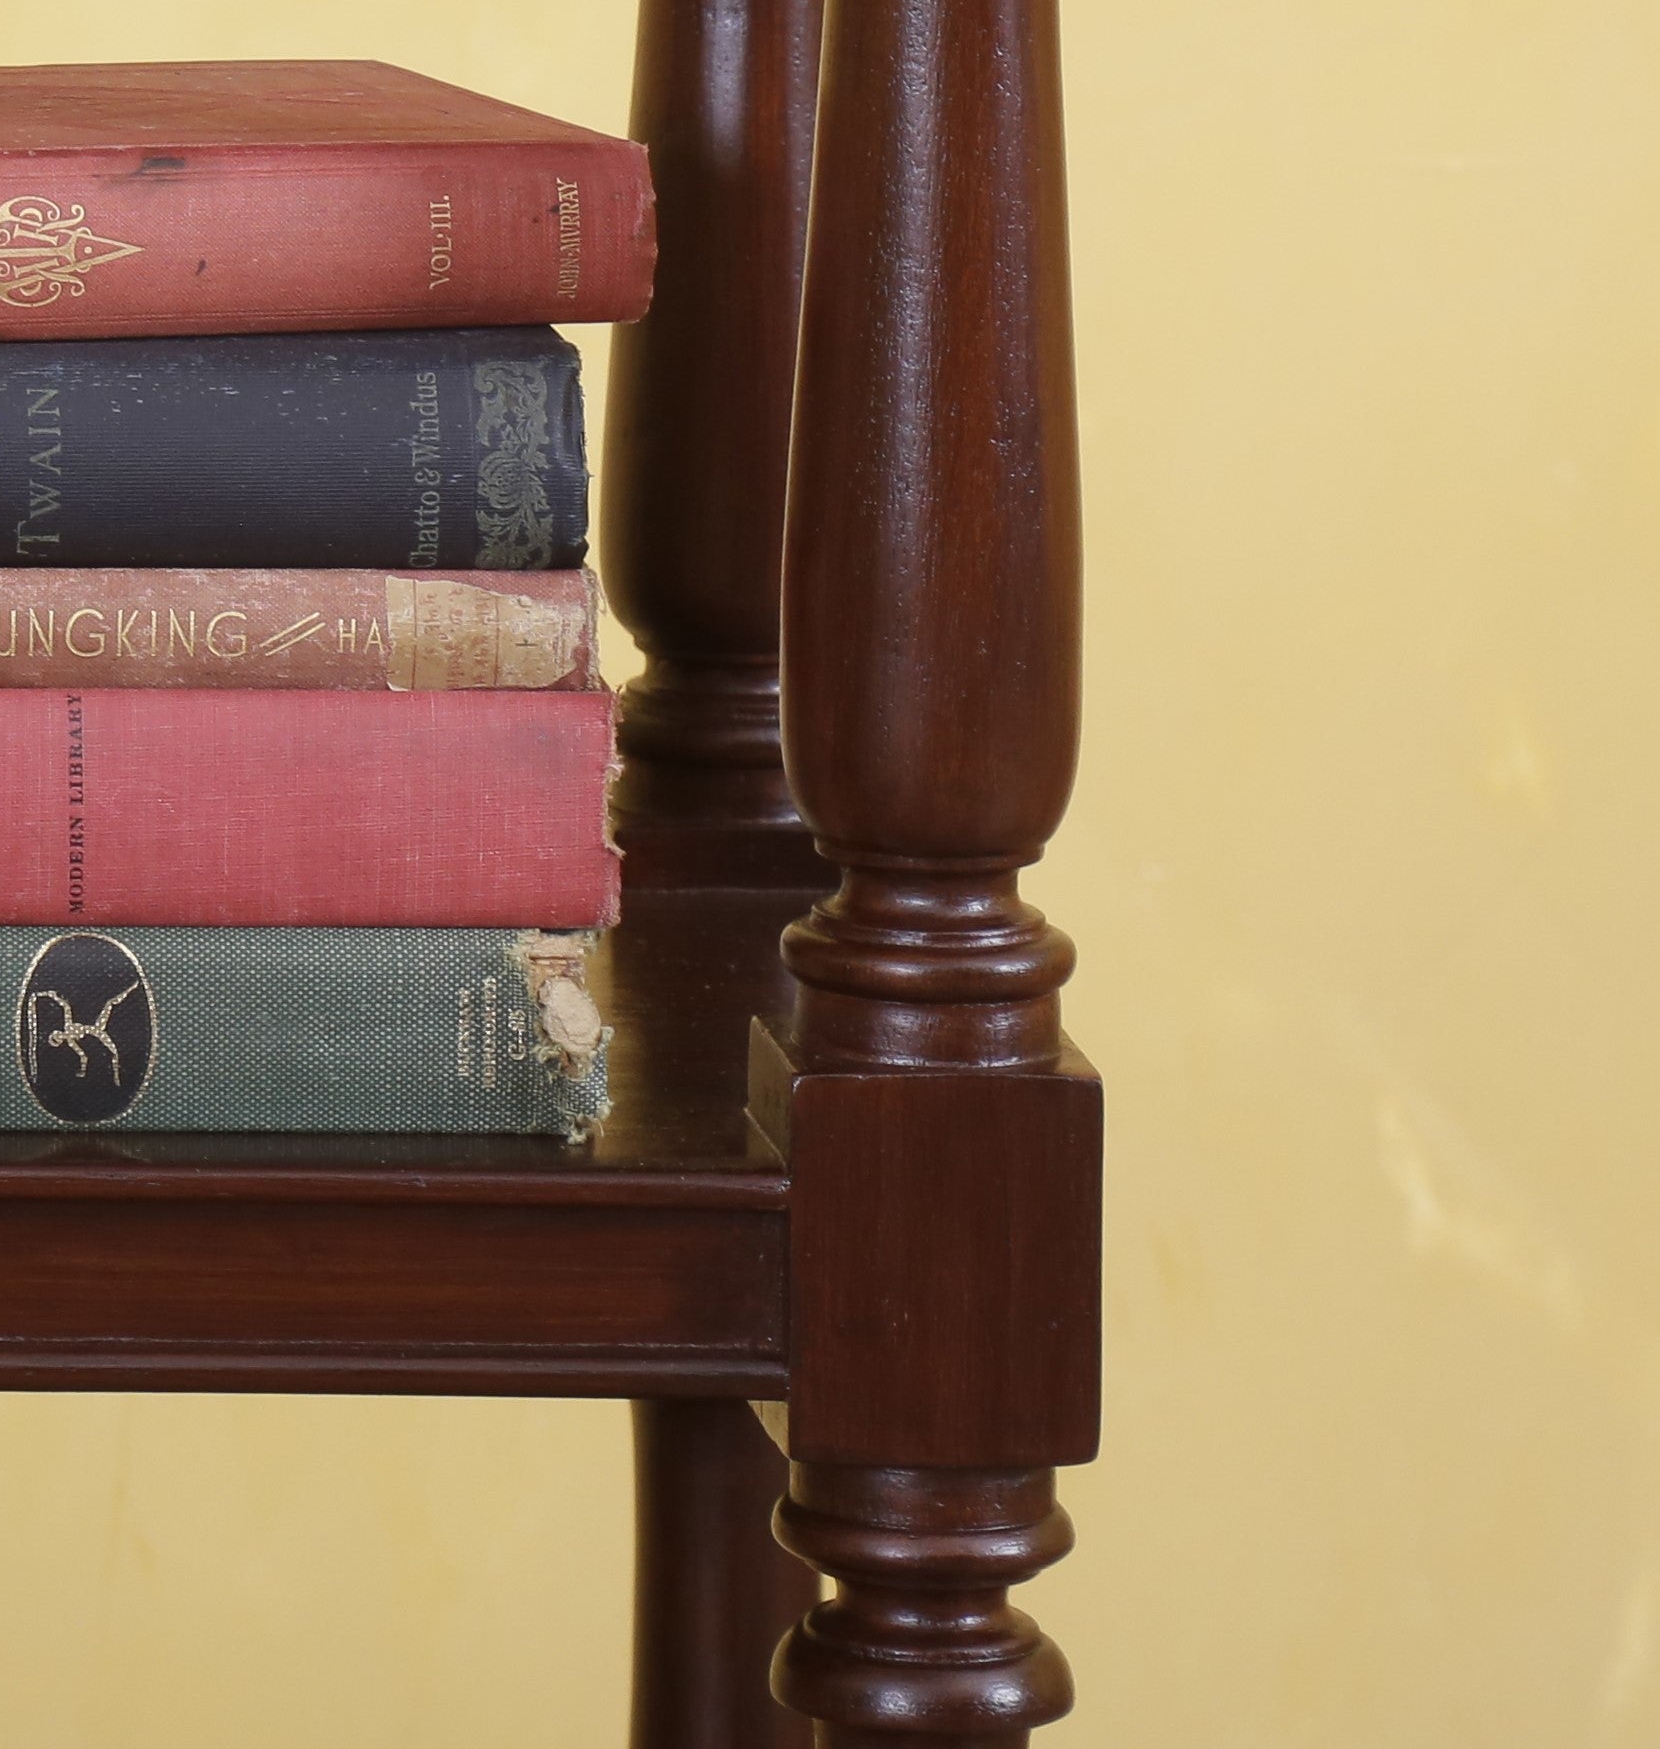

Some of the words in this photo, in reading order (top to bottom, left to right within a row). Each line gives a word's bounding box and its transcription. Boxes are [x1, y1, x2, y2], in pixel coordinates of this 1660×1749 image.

[410, 371, 441, 467] Windus
[17, 386, 61, 554] TWAIN
[415, 470, 440, 485] &
[409, 491, 440, 568] Chatto
[66, 692, 84, 808] LIBRARY
[67, 816, 84, 915] MODERN
